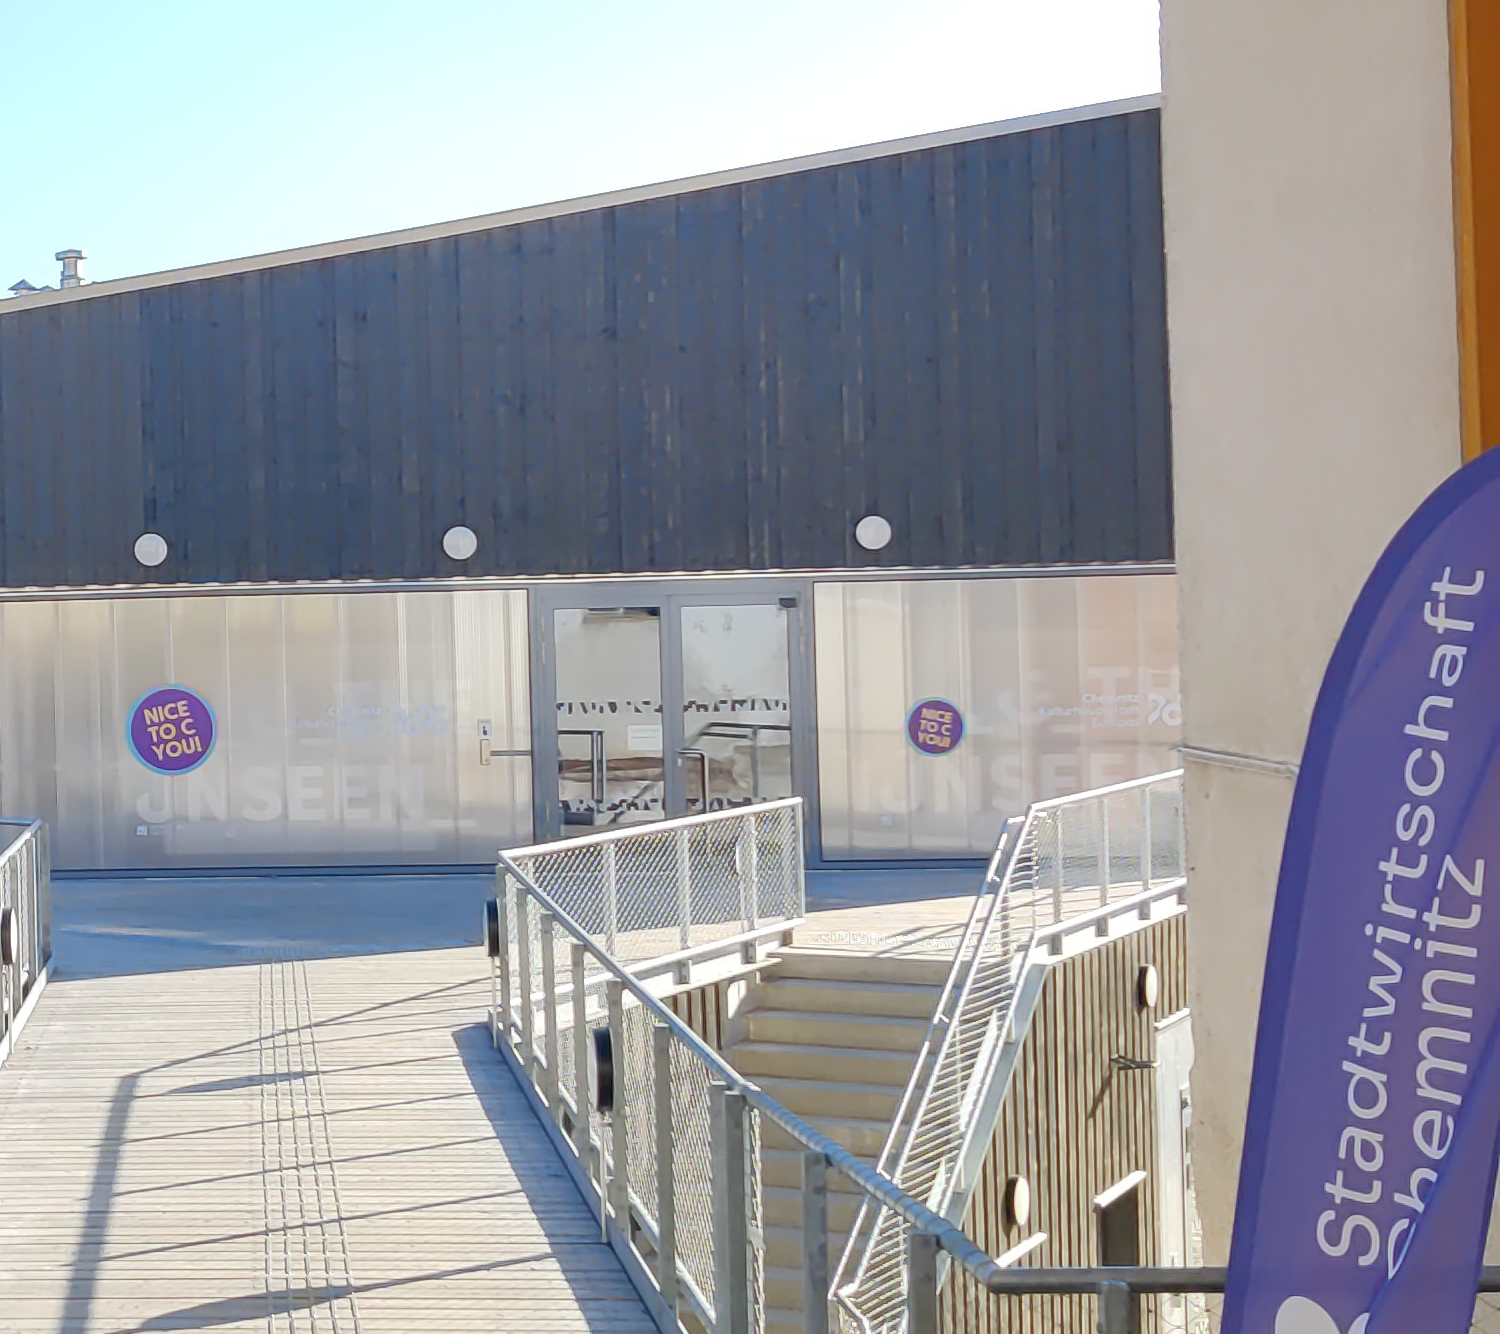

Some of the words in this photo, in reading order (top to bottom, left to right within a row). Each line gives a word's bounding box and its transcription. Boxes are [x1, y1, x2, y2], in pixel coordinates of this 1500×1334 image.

[143, 699, 191, 726] NICE
[920, 707, 954, 724] NICE
[147, 723, 177, 743] TO
[180, 718, 197, 735] C
[919, 719, 939, 733] TO
[941, 724, 953, 736] C
[1315, 565, 1485, 1267] Stadtwirtschaft
